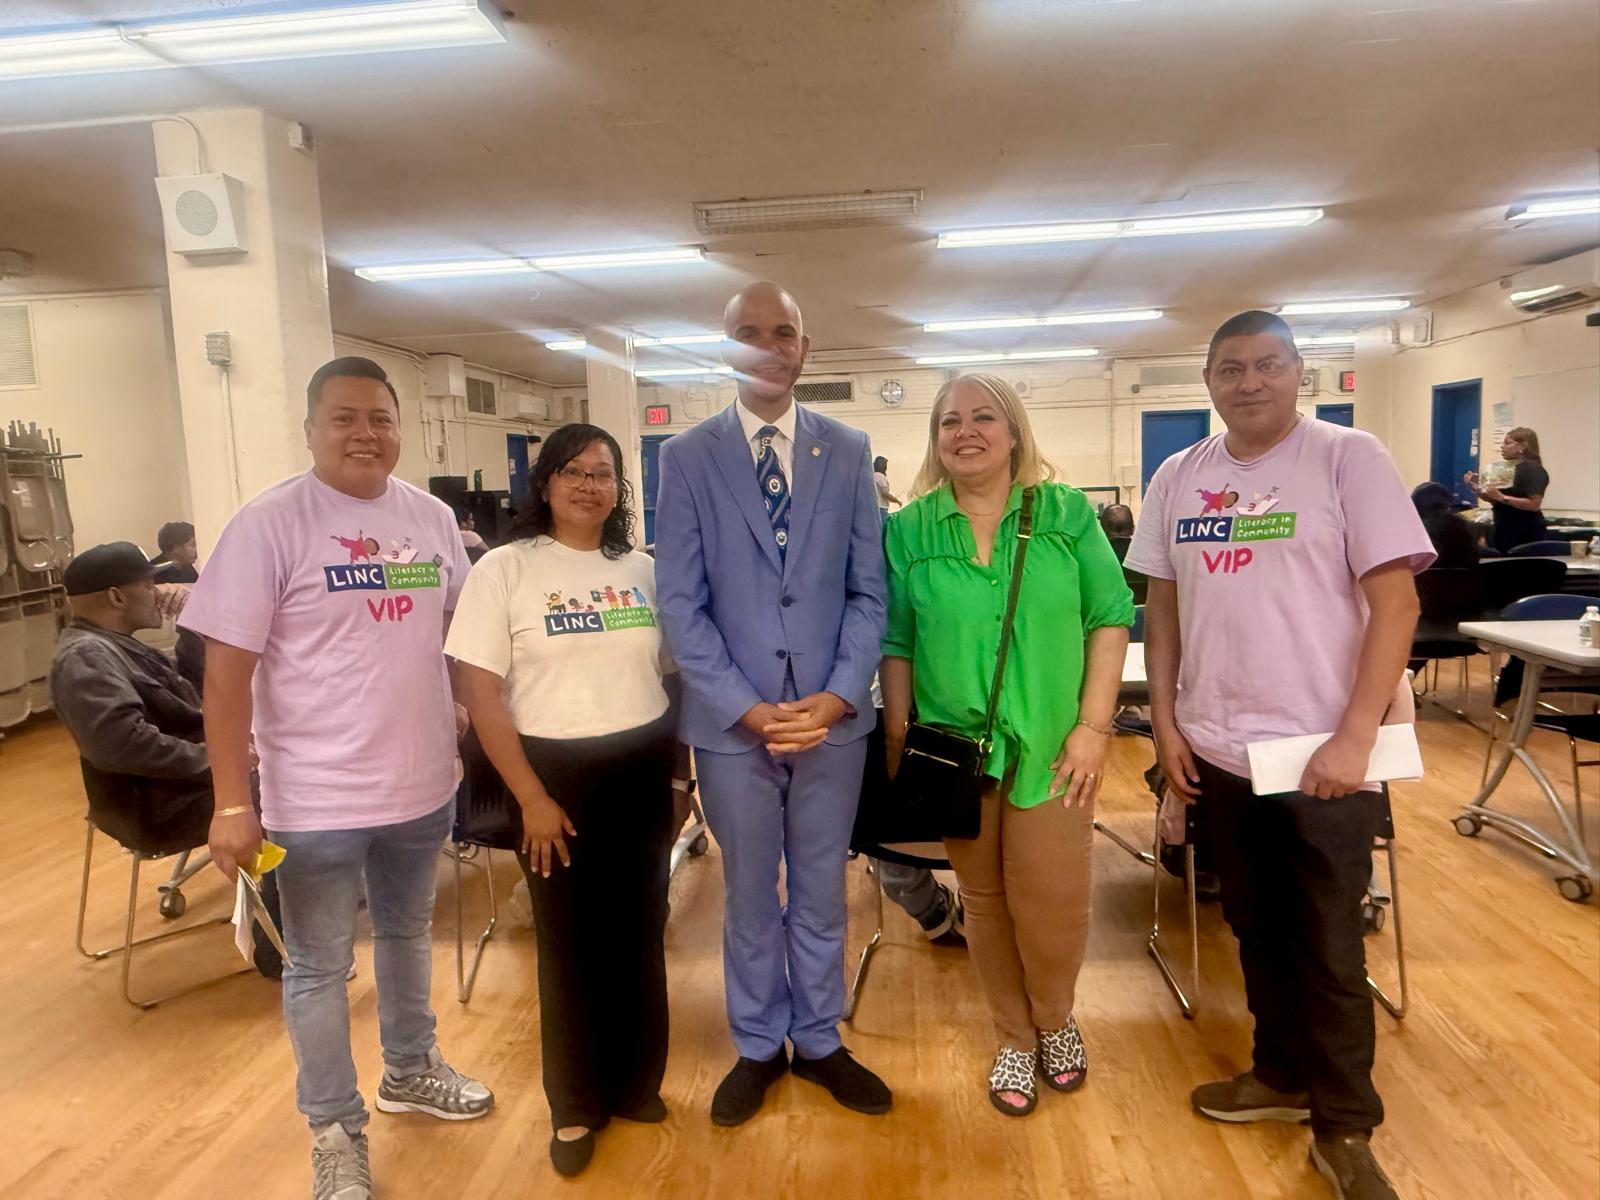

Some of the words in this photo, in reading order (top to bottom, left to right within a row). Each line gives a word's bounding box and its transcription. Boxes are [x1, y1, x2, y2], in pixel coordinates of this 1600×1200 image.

[1179, 520, 1227, 539] LINC
[1237, 526, 1290, 537] Community
[1239, 517, 1277, 528] Literacy
[1202, 547, 1253, 574] VIP
[330, 568, 382, 587] LINC
[389, 566, 426, 576] Literacy
[366, 595, 413, 622] VIP
[549, 615, 599, 632] LINC
